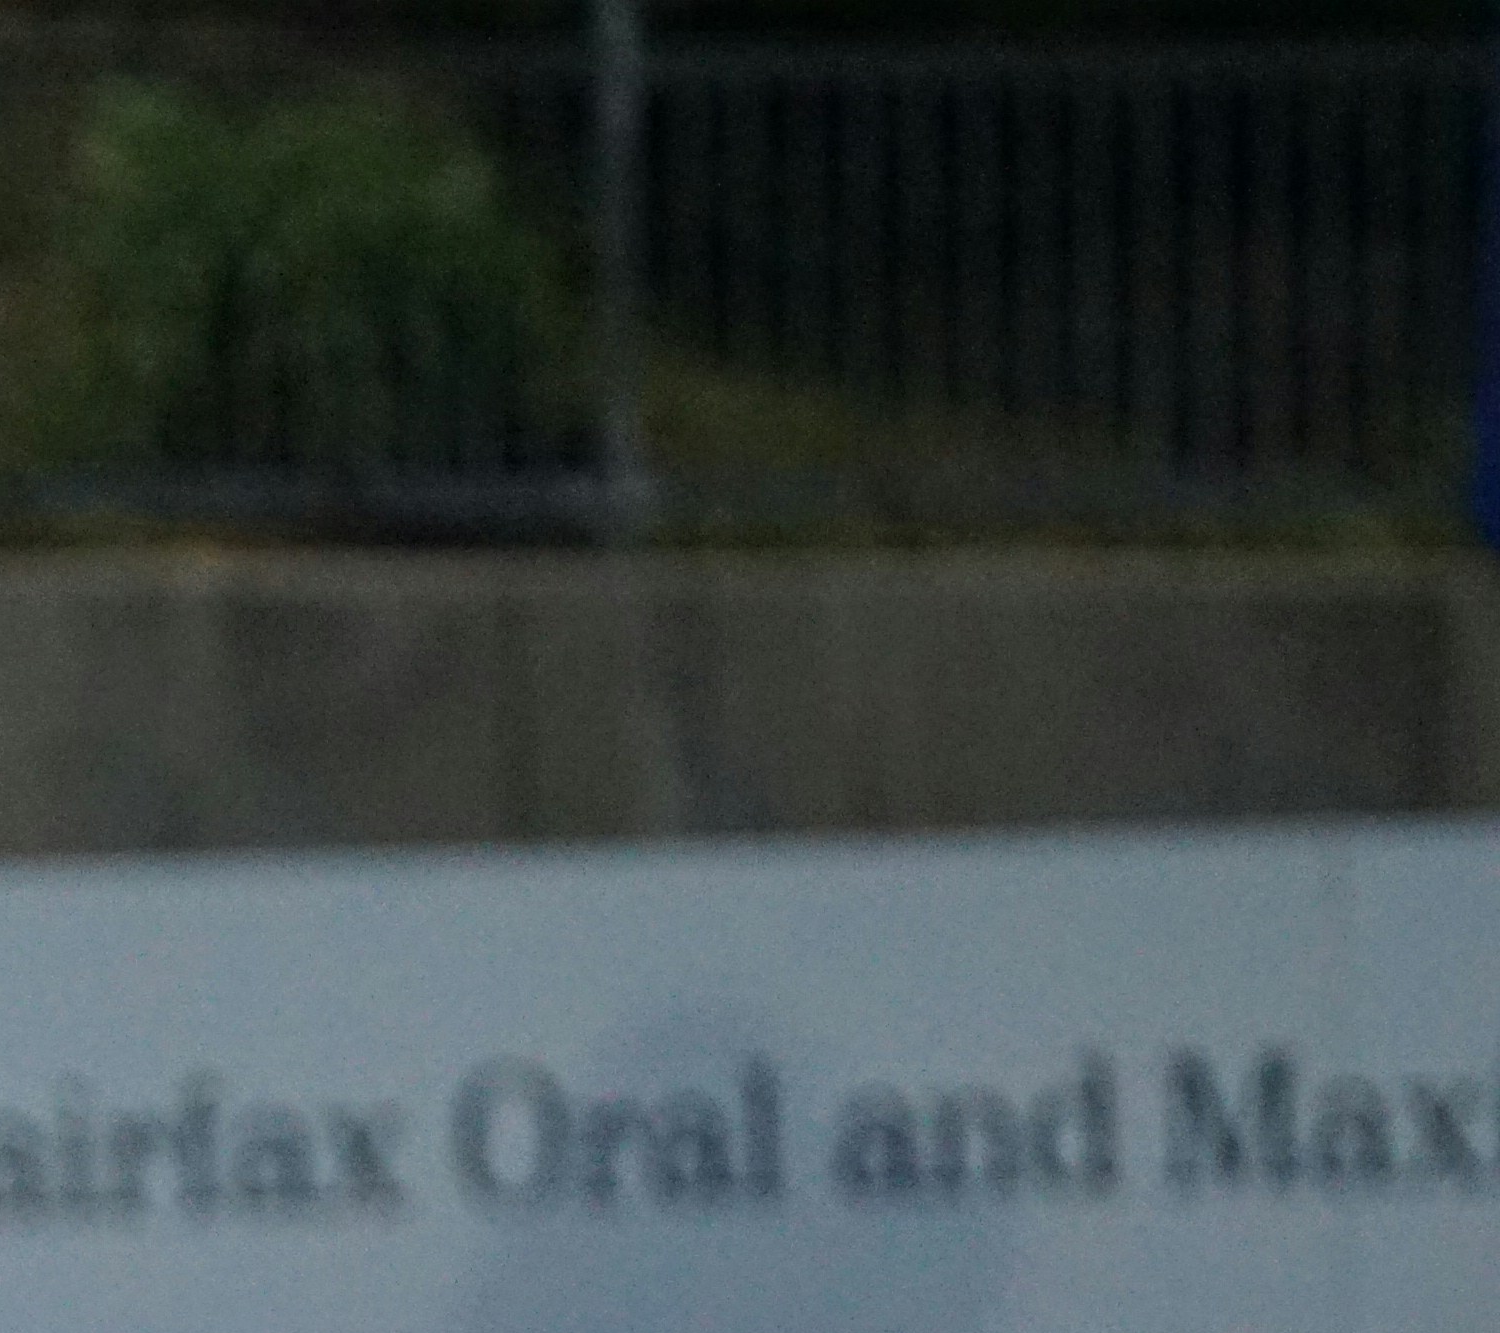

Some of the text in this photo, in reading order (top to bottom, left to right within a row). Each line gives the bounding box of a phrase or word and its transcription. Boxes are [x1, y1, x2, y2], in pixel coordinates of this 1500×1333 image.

[450, 1054, 788, 1208] Oral
[830, 1044, 1118, 1198] and
[1158, 1040, 1500, 1194] Max
